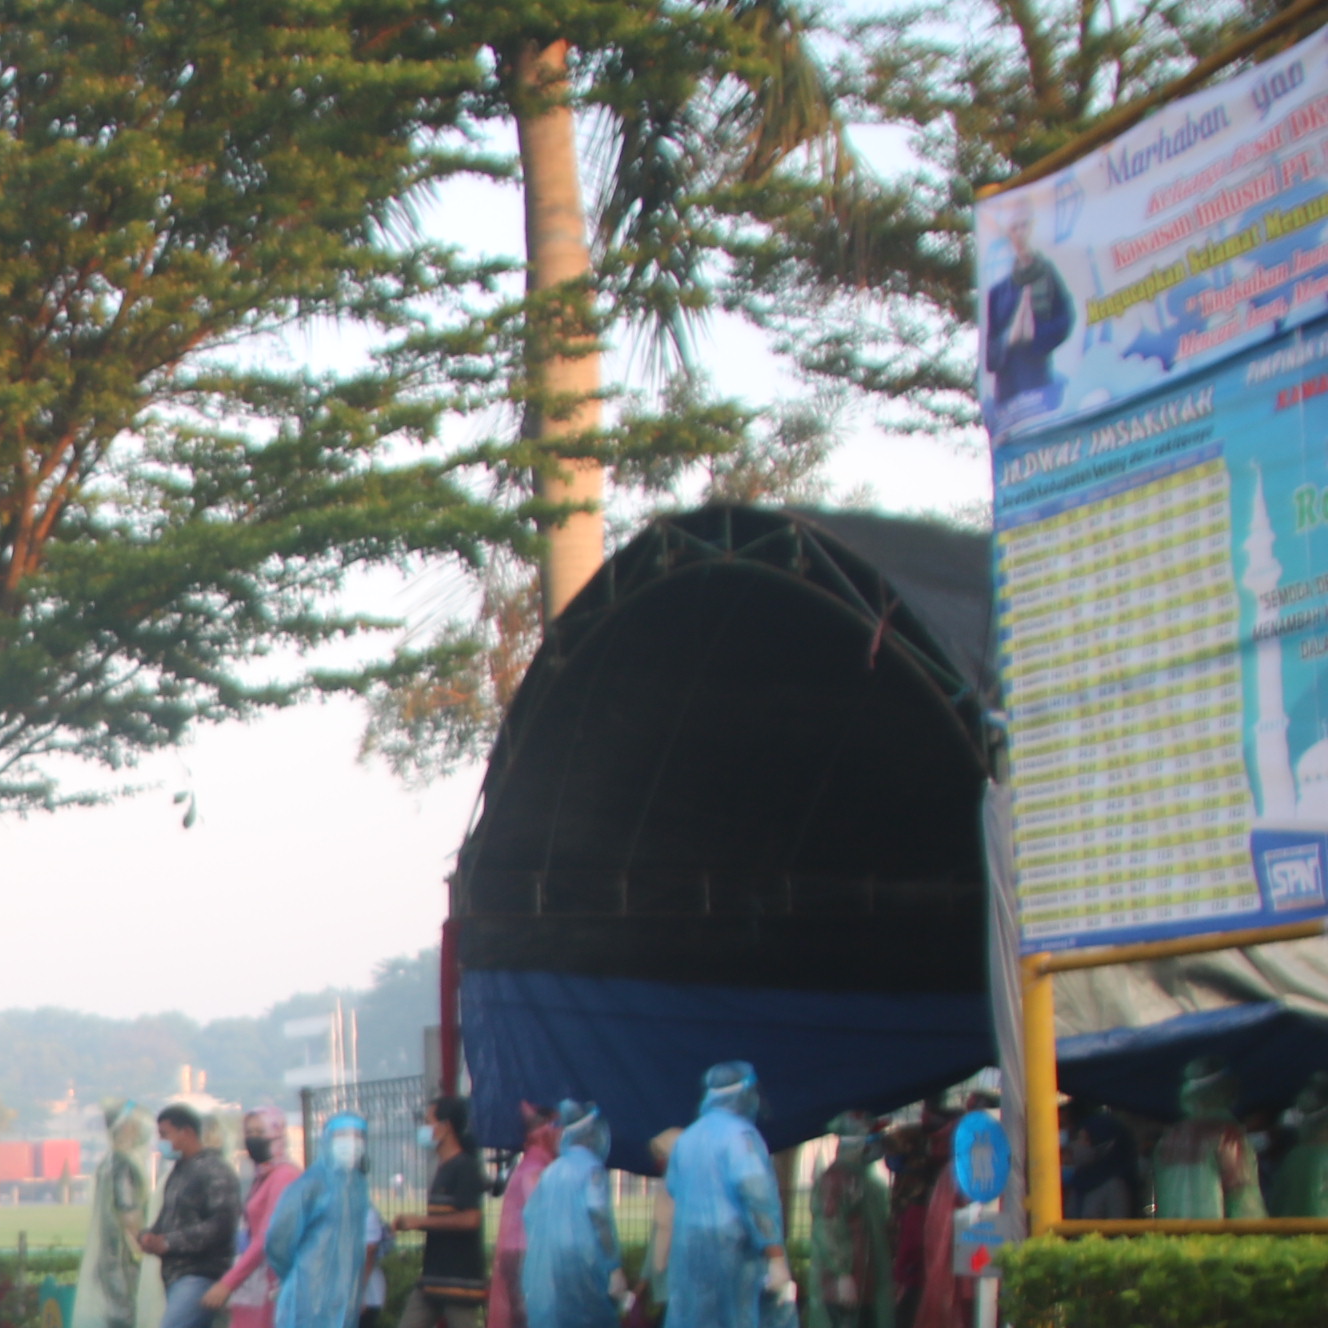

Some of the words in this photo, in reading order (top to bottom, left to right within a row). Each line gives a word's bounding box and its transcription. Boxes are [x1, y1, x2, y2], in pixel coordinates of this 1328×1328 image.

[1289, 95, 1328, 138] DK
[1106, 103, 1230, 188] Marhaban
[1113, 214, 1193, 271] Kawasan
[1195, 162, 1281, 228] Industri
[1187, 225, 1261, 275] Selamat
[1001, 437, 1082, 486] JADWAL
[1087, 385, 1214, 457] IMSAKIYAH
[1253, 606, 1322, 642] MENAMBAH
[1272, 857, 1320, 896] SPN
